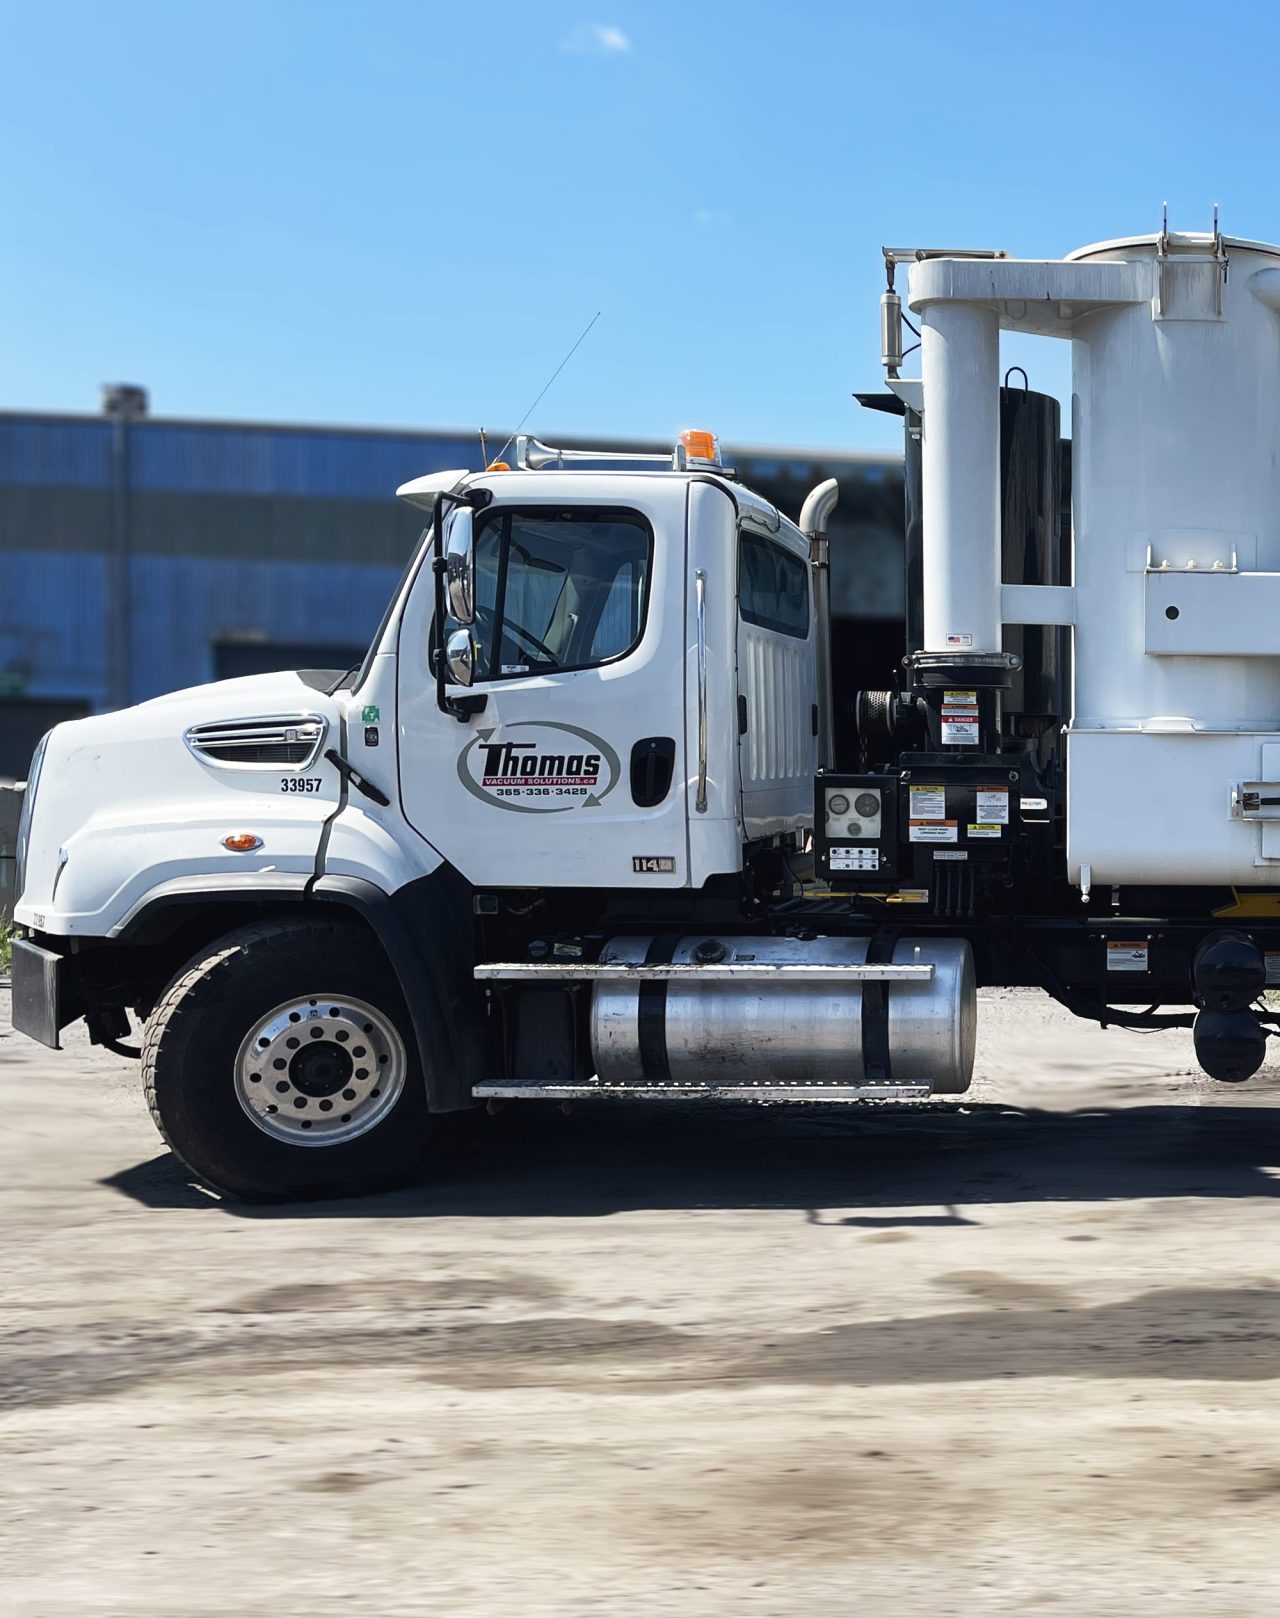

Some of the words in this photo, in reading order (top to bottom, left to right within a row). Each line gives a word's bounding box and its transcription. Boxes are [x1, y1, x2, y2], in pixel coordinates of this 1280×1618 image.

[478, 742, 601, 777] Thomas
[281, 778, 322, 792] 33957
[485, 777, 525, 785] VACUUM
[528, 777, 595, 785] SOLUTIONS.ca
[634, 858, 659, 871] 114
